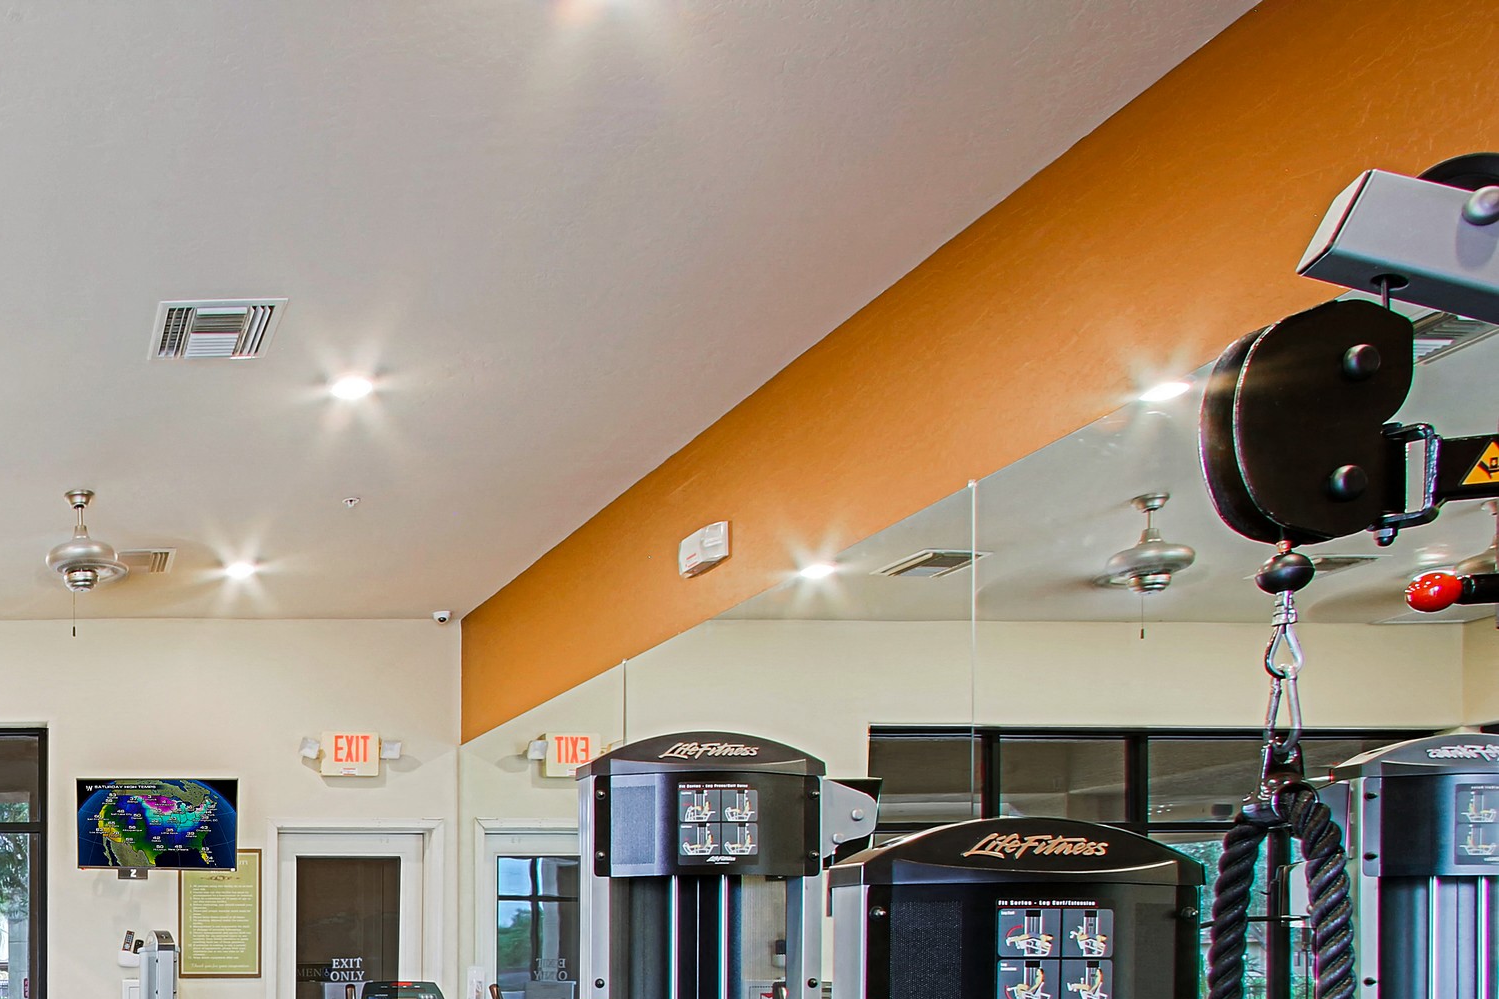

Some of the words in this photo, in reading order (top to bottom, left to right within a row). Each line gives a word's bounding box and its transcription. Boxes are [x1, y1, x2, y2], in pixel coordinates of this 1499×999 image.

[334, 735, 370, 762] EXIT
[332, 957, 362, 968] EXIT
[330, 971, 364, 981] ONLY
